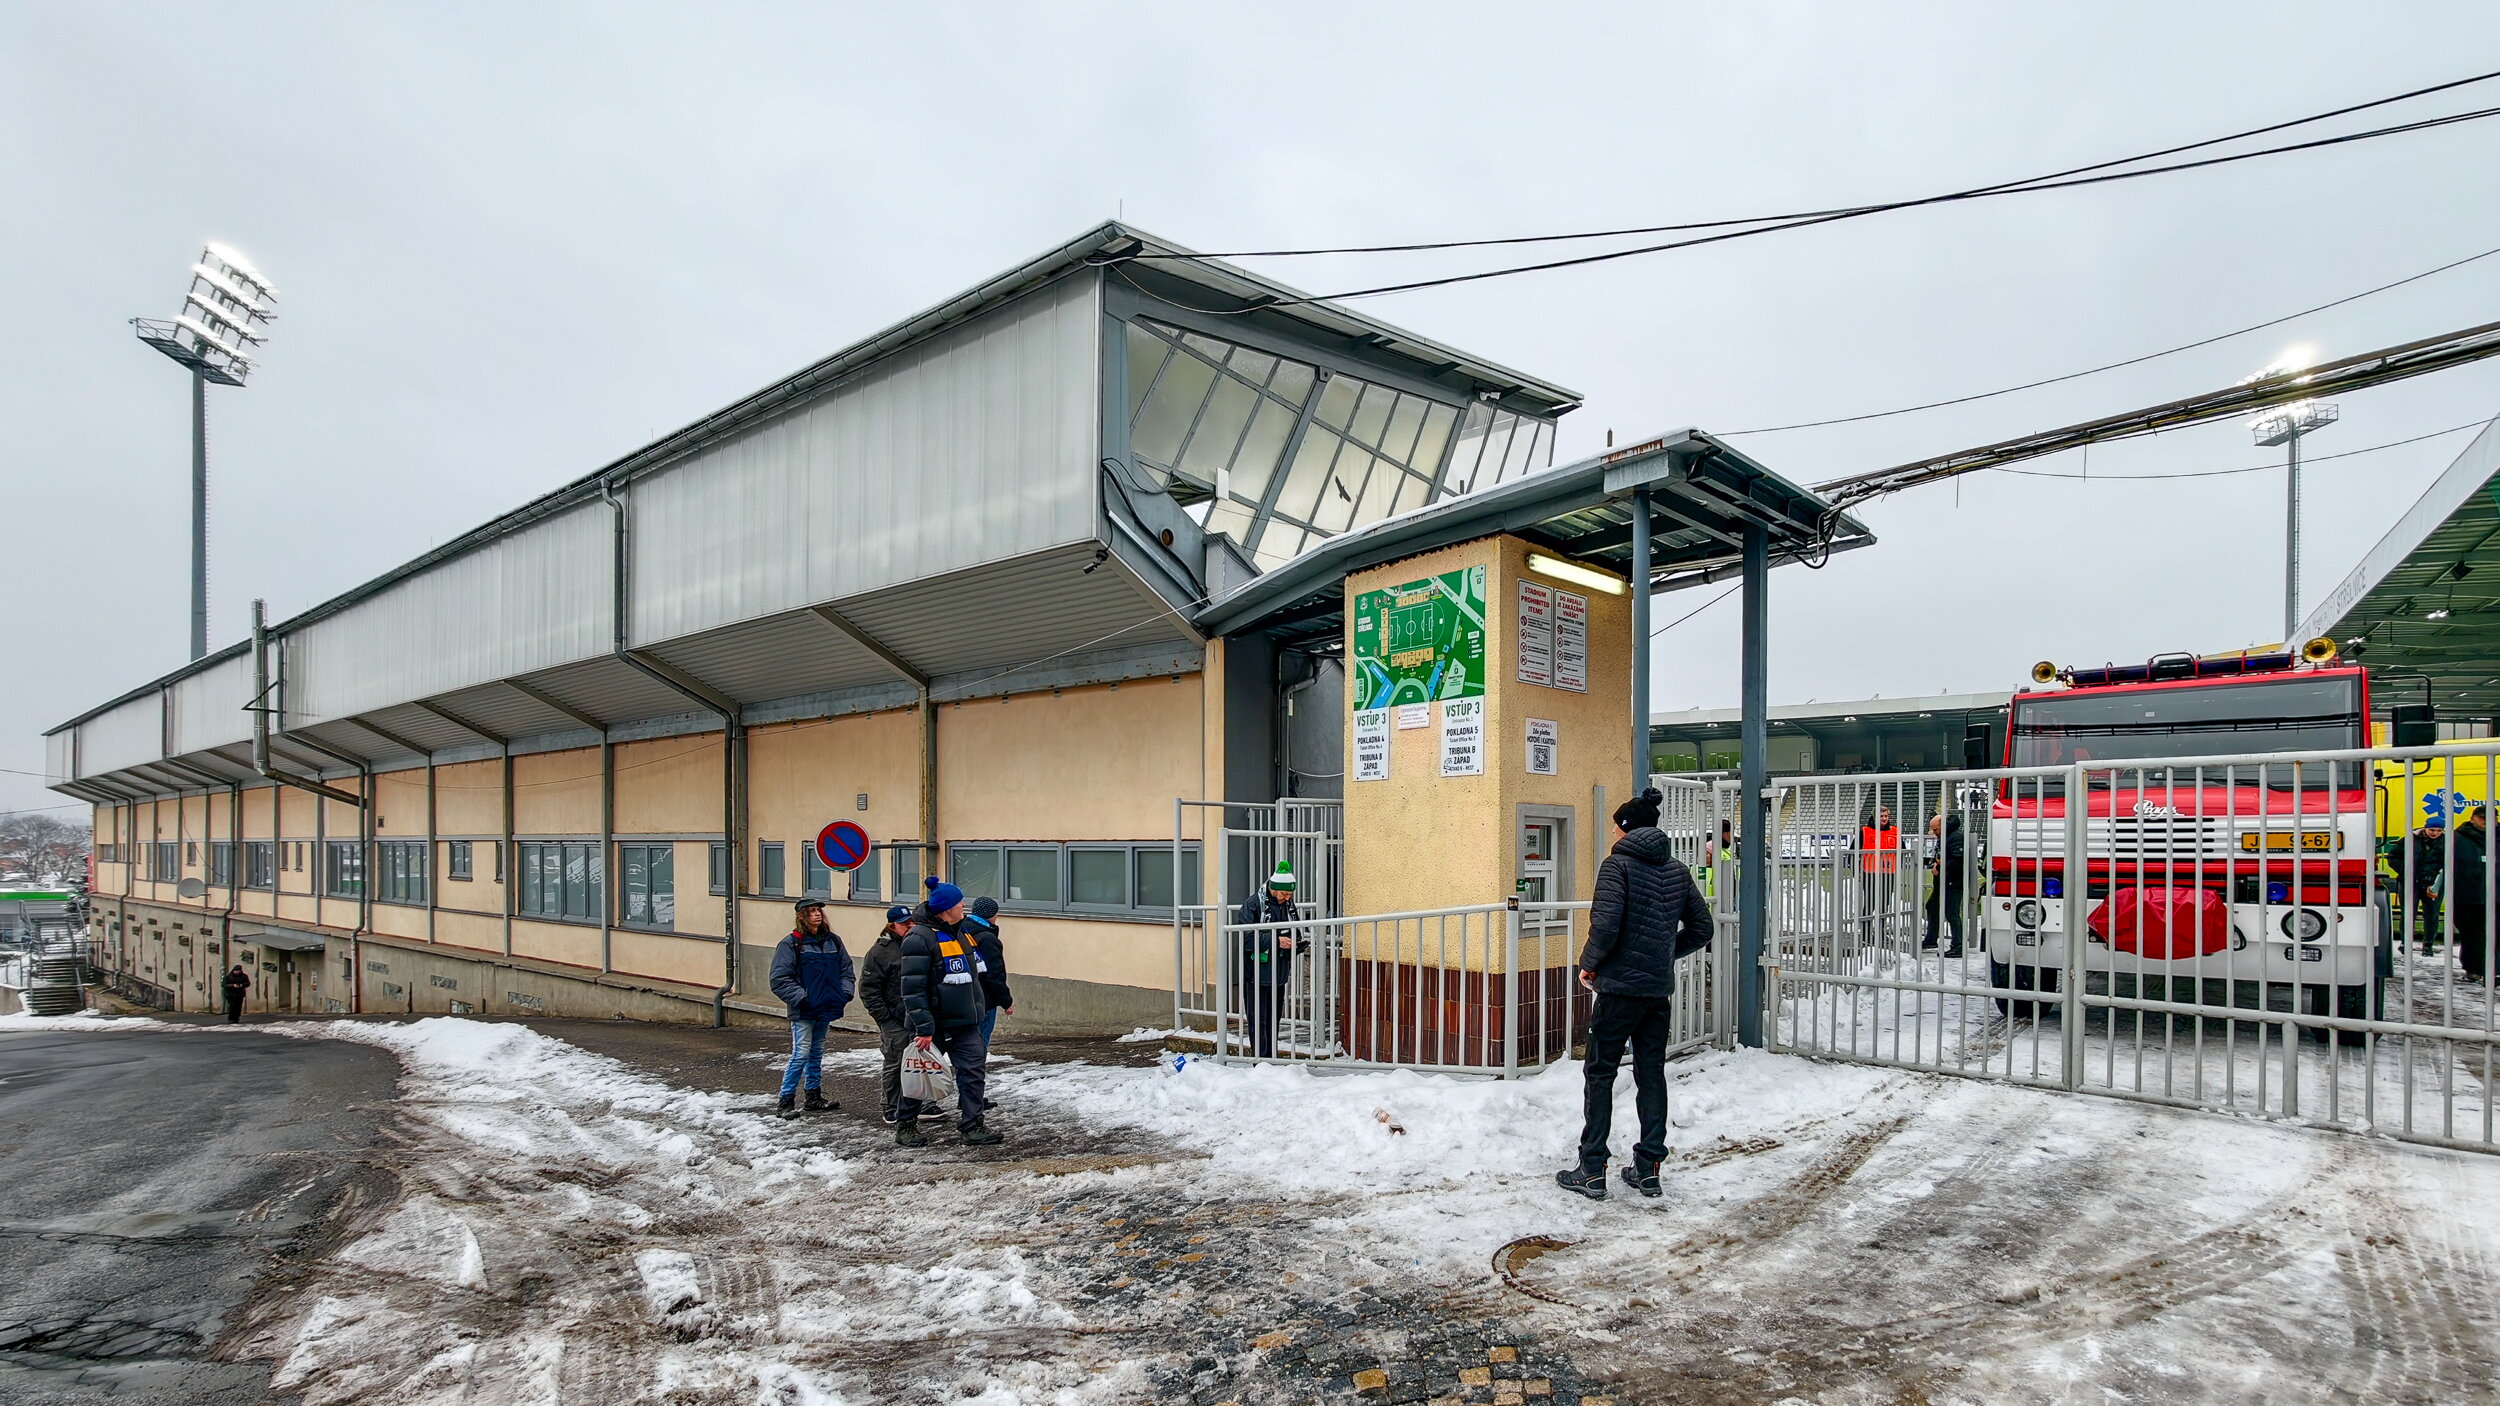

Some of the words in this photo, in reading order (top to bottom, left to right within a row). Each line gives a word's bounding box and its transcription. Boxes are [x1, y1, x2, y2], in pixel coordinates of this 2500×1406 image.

[1524, 586, 1547, 598] STADIUM
[1520, 595, 1550, 608] PROHIBITED
[1527, 605, 1543, 616] ITEMS
[1445, 702, 1473, 718] VSTUP
[1474, 701, 1480, 714] 3
[1356, 713, 1380, 727] VSTUP
[1381, 712, 1387, 725] 3
[1446, 727, 1474, 737] POKLADNA
[1474, 726, 1479, 734] 5
[1357, 736, 1380, 745] POKLADNA
[1448, 746, 1471, 755] TRIBUNA
[1359, 753, 1378, 762] TRIBUNA
[905, 1058, 943, 1070] TESCO
